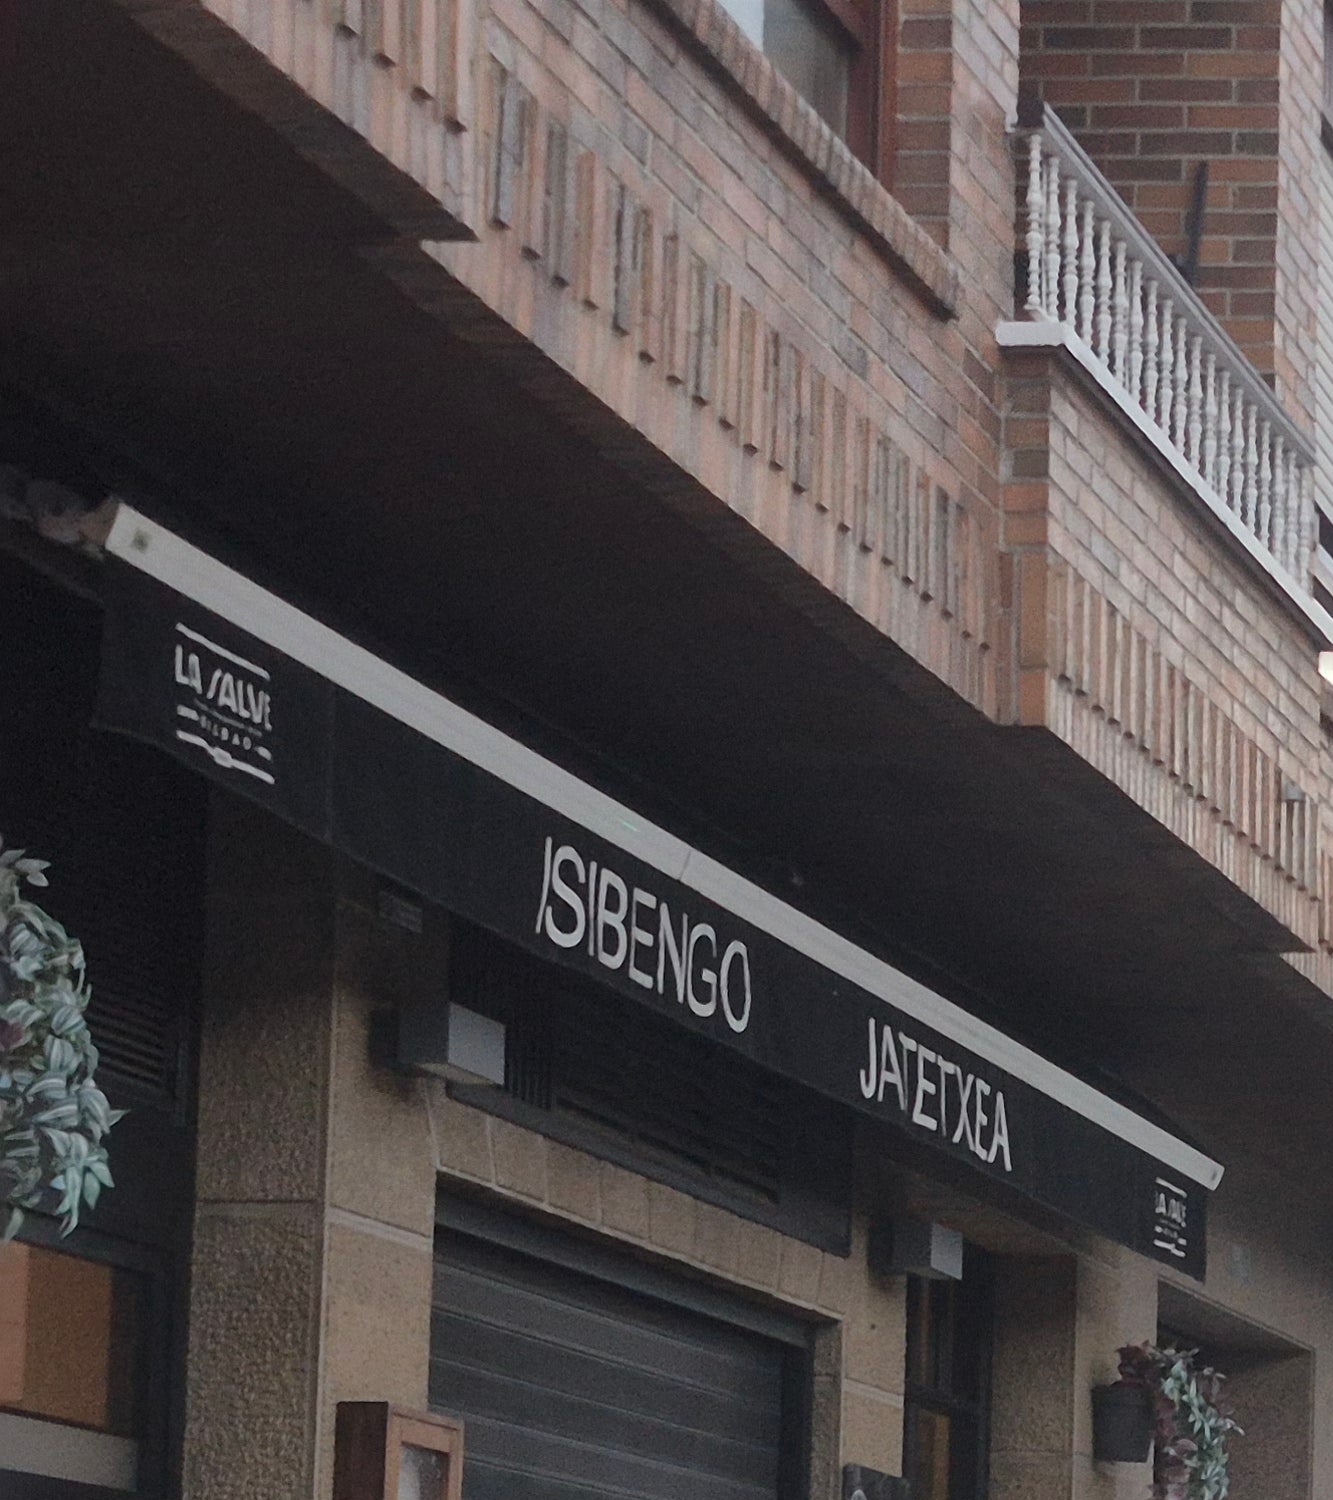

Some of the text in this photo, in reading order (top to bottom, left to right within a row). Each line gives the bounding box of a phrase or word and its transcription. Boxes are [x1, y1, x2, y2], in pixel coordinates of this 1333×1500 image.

[174, 644, 203, 695] LA
[535, 836, 752, 1033] ISIBENGO
[859, 1018, 1012, 1172] JATETXEA
